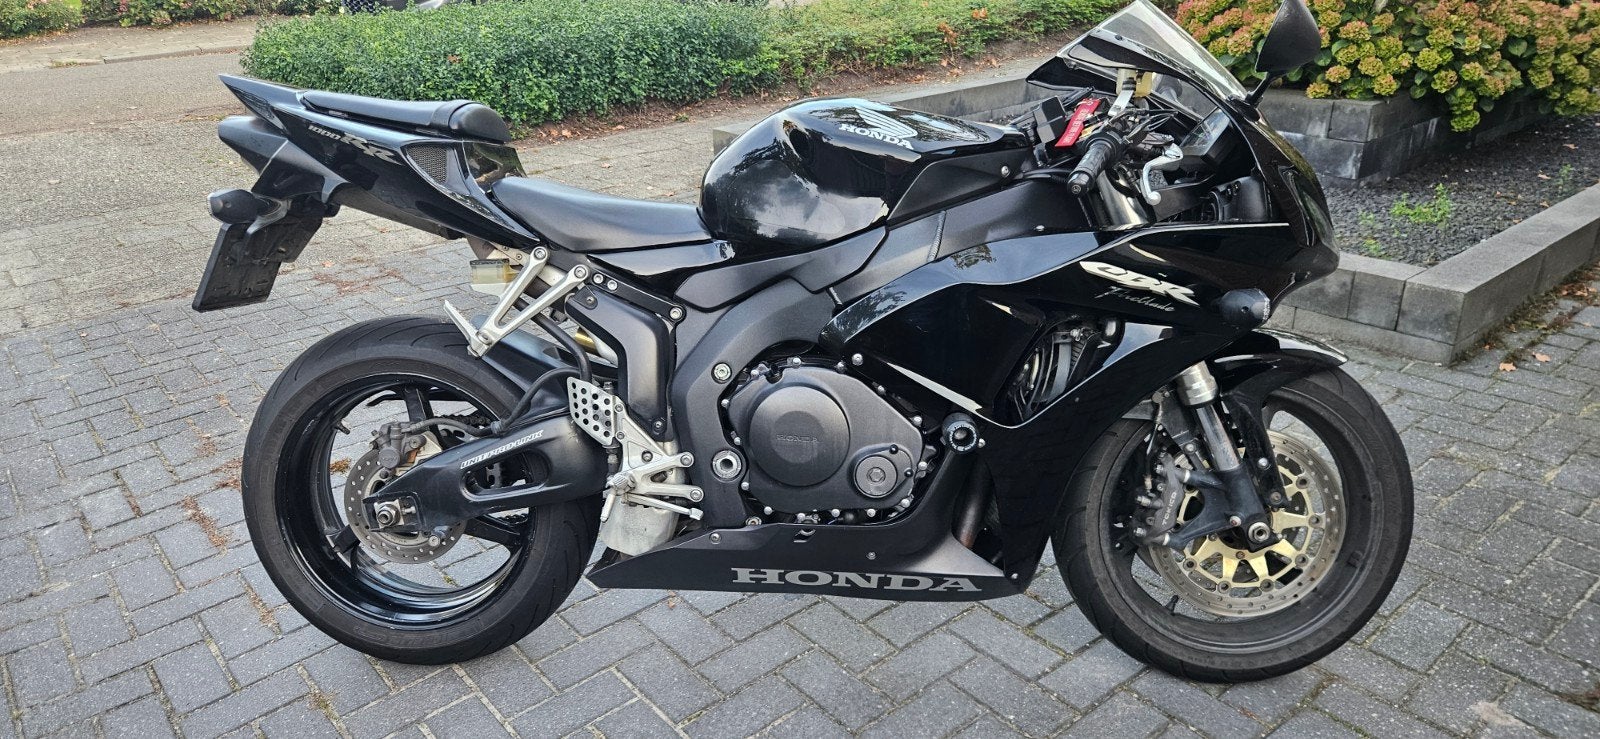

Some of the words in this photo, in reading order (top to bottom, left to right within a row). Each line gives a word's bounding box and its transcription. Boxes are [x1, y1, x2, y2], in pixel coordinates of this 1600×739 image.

[308, 124, 341, 140] 1000
[340, 131, 405, 166] RR
[839, 123, 914, 150] HONDA
[1079, 261, 1200, 306] CBR
[1094, 285, 1176, 312] Fireblade
[776, 434, 820, 444] HONDA
[731, 567, 982, 592] HONDA
